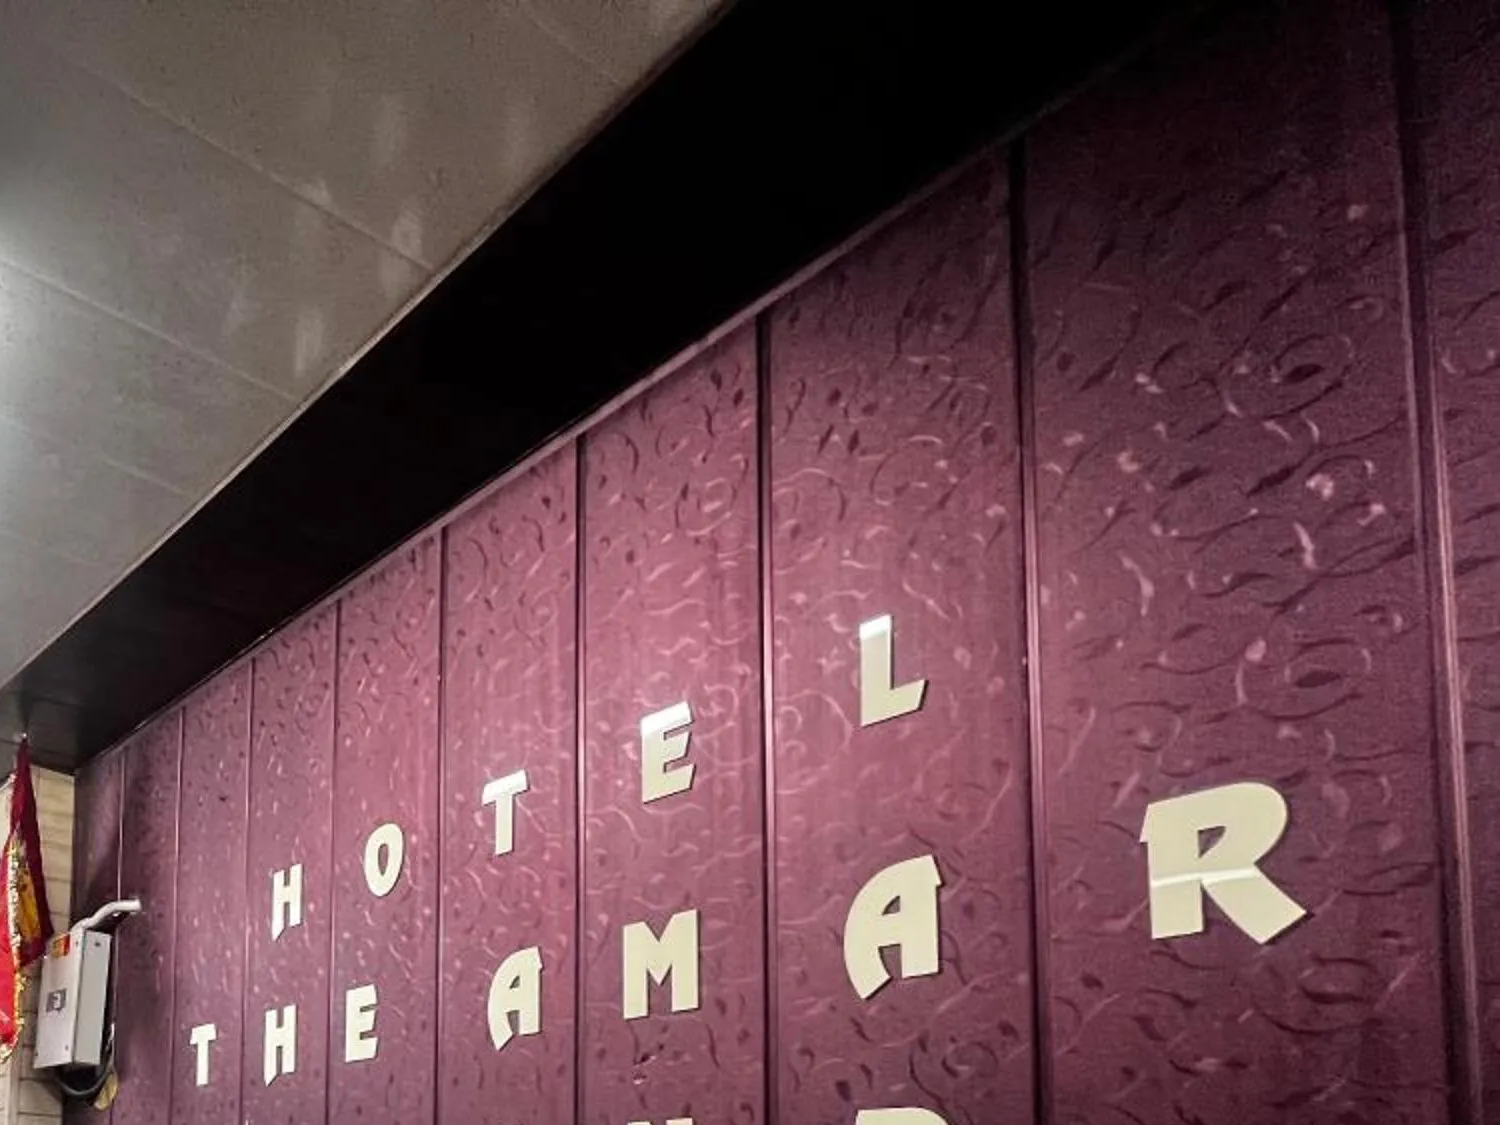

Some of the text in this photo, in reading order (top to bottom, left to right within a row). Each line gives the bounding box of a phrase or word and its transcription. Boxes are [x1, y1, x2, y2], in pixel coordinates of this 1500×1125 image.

[188, 782, 1306, 1087] THE AMAR
[271, 613, 927, 941] HOTEL
